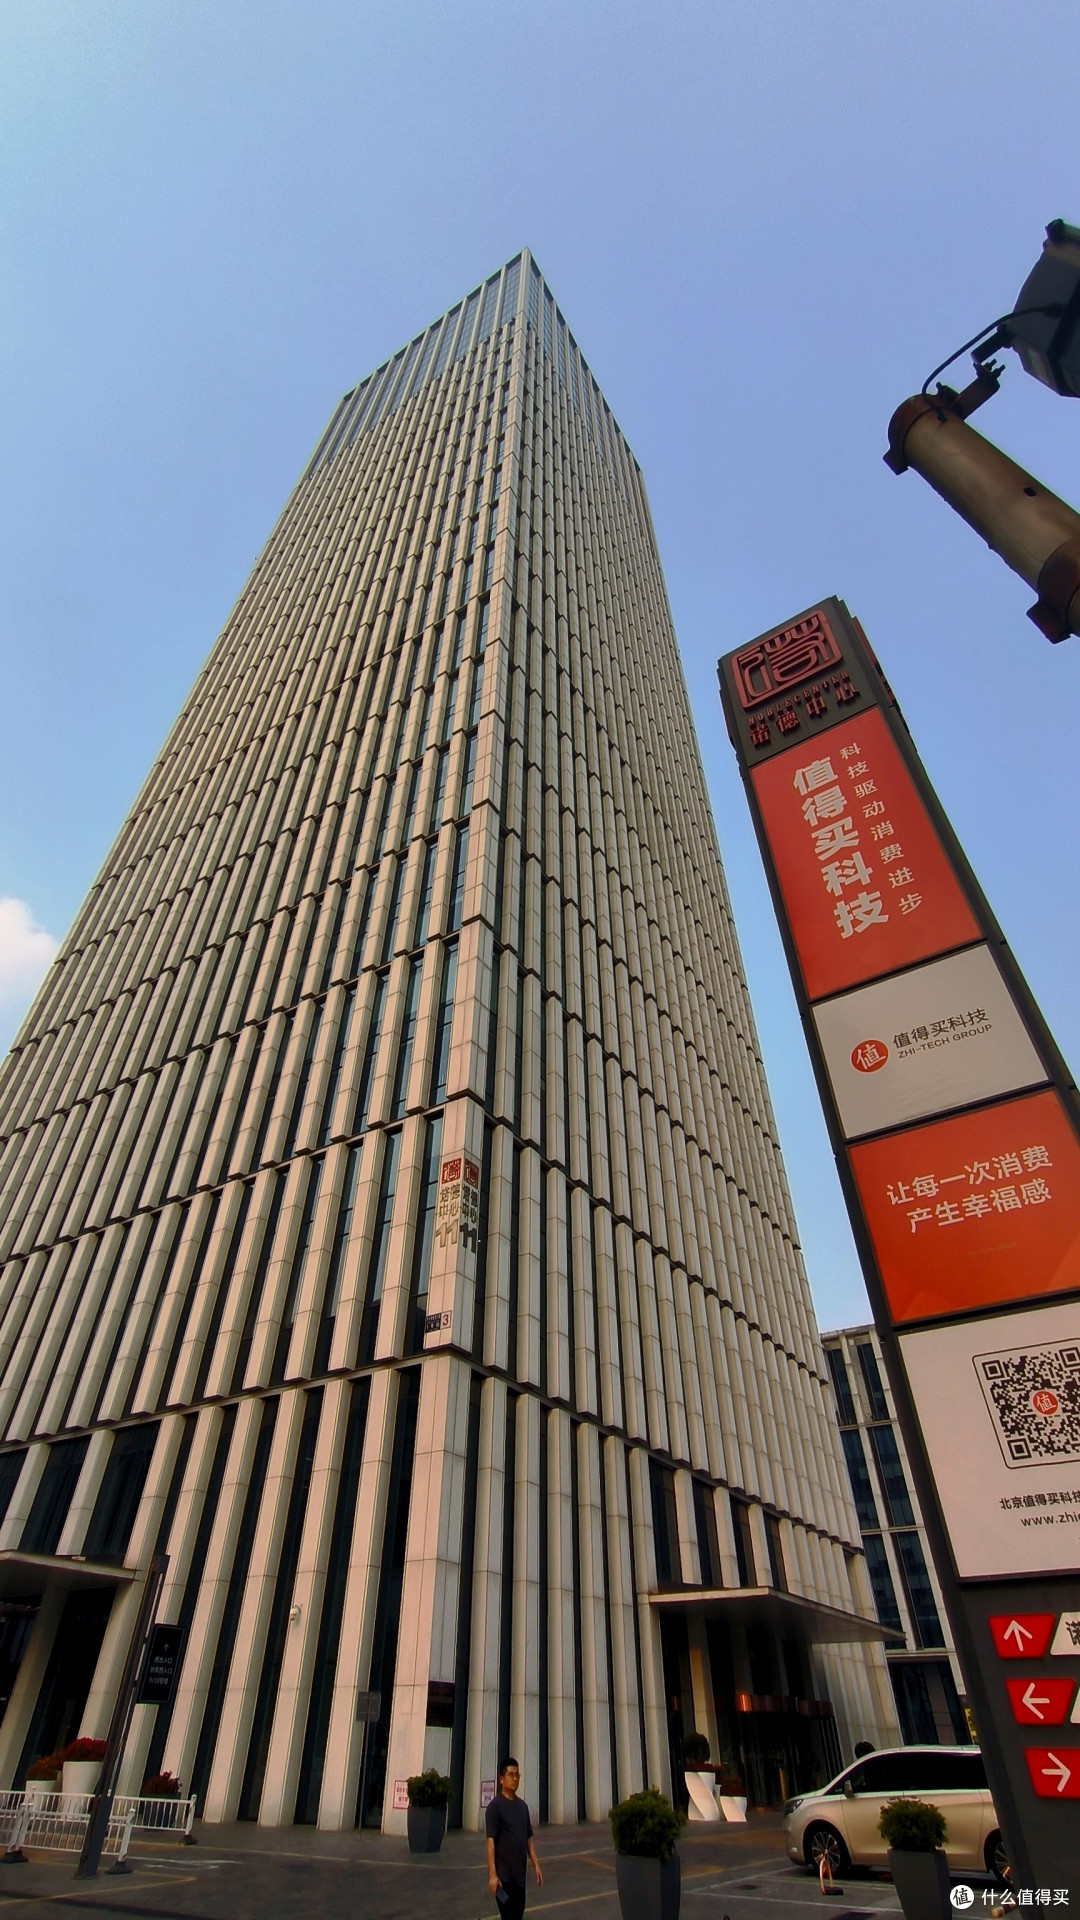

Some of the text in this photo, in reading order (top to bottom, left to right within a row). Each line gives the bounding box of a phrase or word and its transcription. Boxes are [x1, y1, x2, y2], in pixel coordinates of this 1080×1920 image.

[839, 742, 923, 915] 科技驱动消费进步
[793, 757, 889, 939] 值得买科技
[892, 1008, 990, 1050] 值得买科技
[952, 1024, 993, 1042] GROUP
[854, 1042, 888, 1071] 值
[886, 1145, 1053, 1206] 让每一次消费
[907, 1178, 1053, 1233] 产生幸福感
[436, 1219, 459, 1248] 11
[460, 1223, 477, 1254] 11
[442, 1314, 449, 1326] 3
[1034, 1392, 1058, 1414] 值
